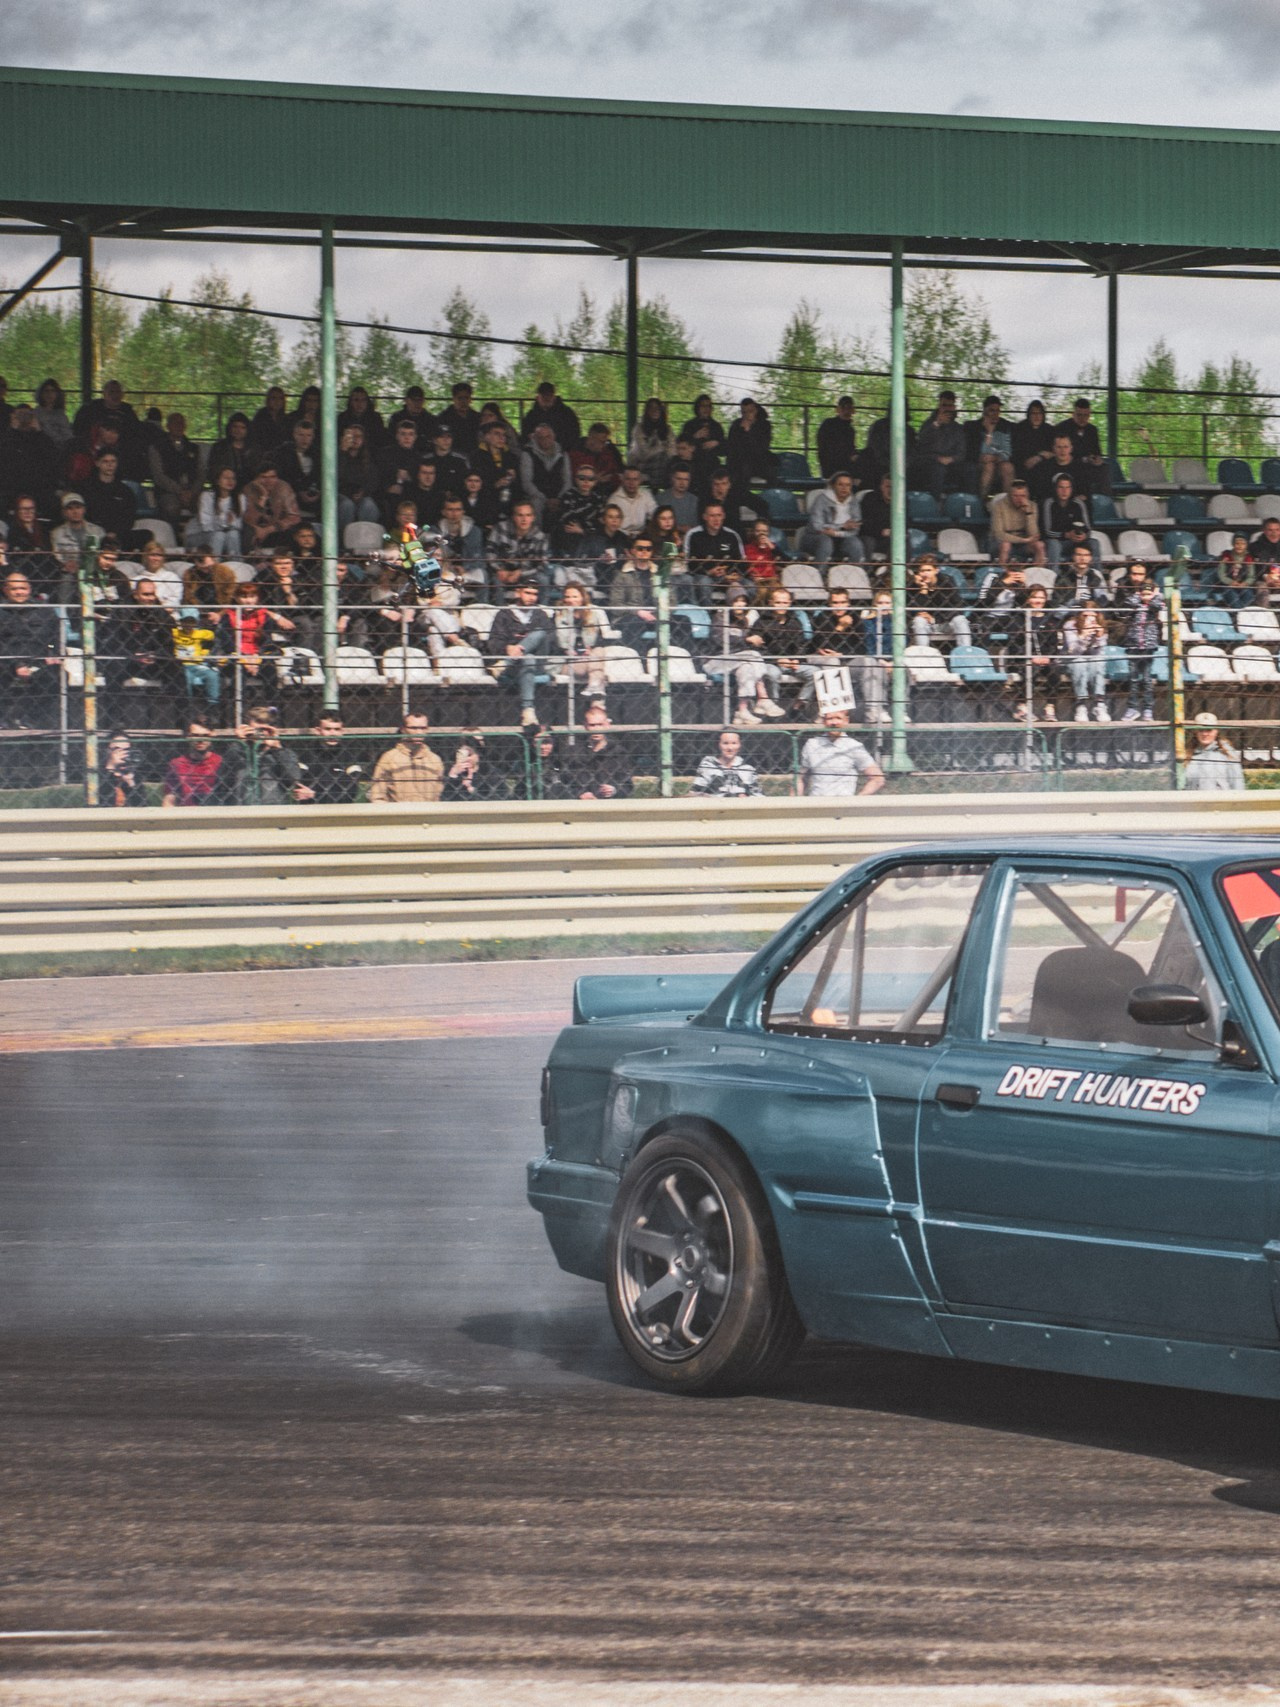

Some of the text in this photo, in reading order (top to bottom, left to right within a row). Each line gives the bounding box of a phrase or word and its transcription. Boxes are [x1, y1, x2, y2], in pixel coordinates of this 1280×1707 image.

[817, 670, 844, 694] 11
[995, 1064, 1207, 1116] DRIFT HUNTERS
